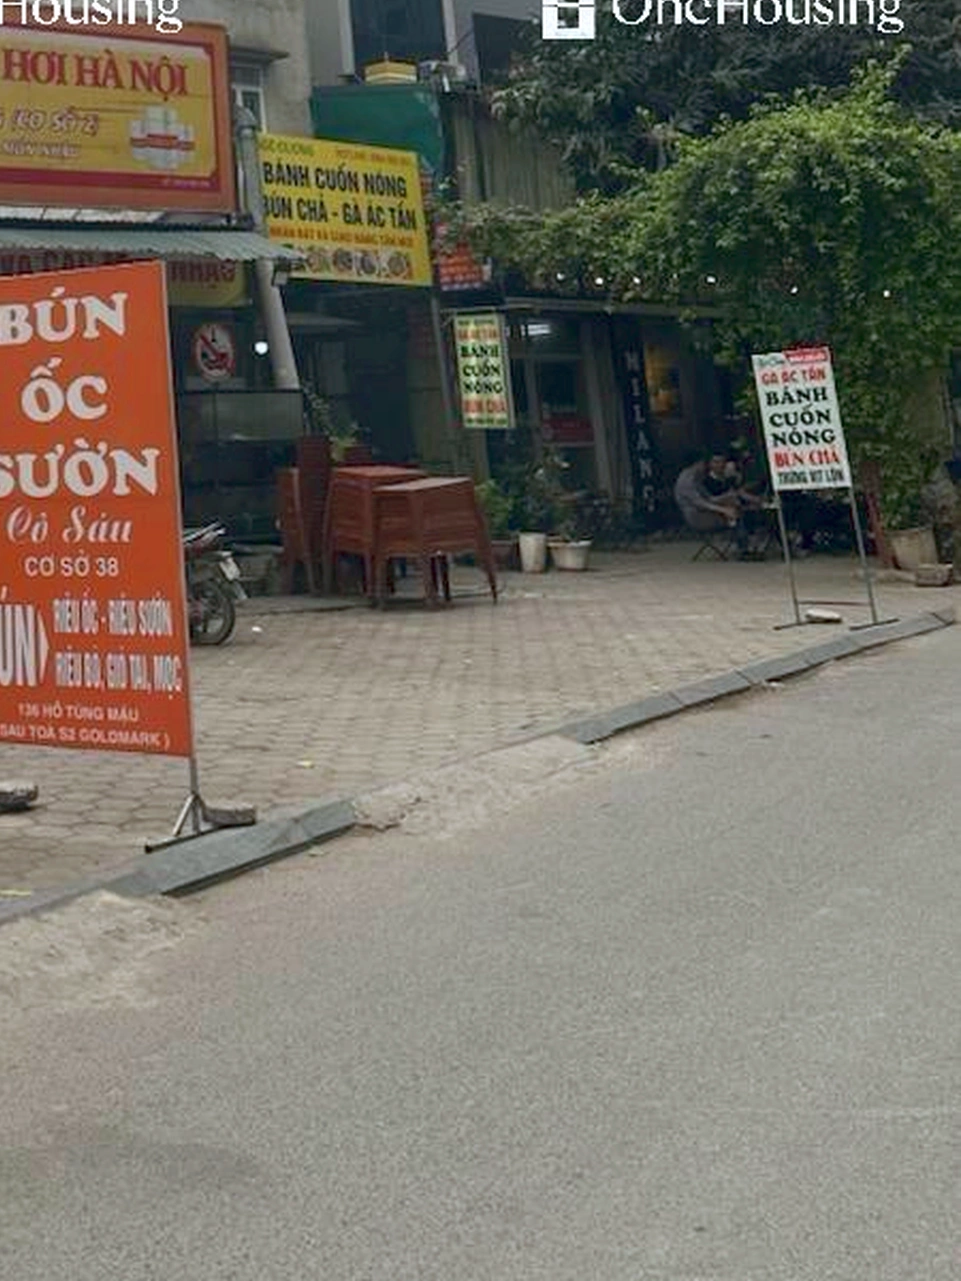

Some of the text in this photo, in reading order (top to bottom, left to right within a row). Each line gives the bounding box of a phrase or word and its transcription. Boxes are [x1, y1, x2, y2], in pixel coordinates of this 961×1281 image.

[2, 45, 69, 86] HƠI
[74, 47, 124, 90] HÀ
[129, 56, 190, 102] NỘI
[262, 158, 311, 188] BÁNH
[315, 162, 360, 194] CUỐN
[296, 192, 329, 224] CHẢ
[21, 357, 108, 423] ỐC
[765, 385, 828, 407] BÁNH
[769, 403, 830, 427] CUỐN
[771, 426, 836, 448] NÓNG
[774, 444, 840, 468] BÚN CHẢ
[7, 505, 134, 543] Cô Sáu
[24, 549, 120, 578] CƠ SỞ 38
[66, 702, 103, 721] TÙNG
[0, 725, 26, 738] SAU
